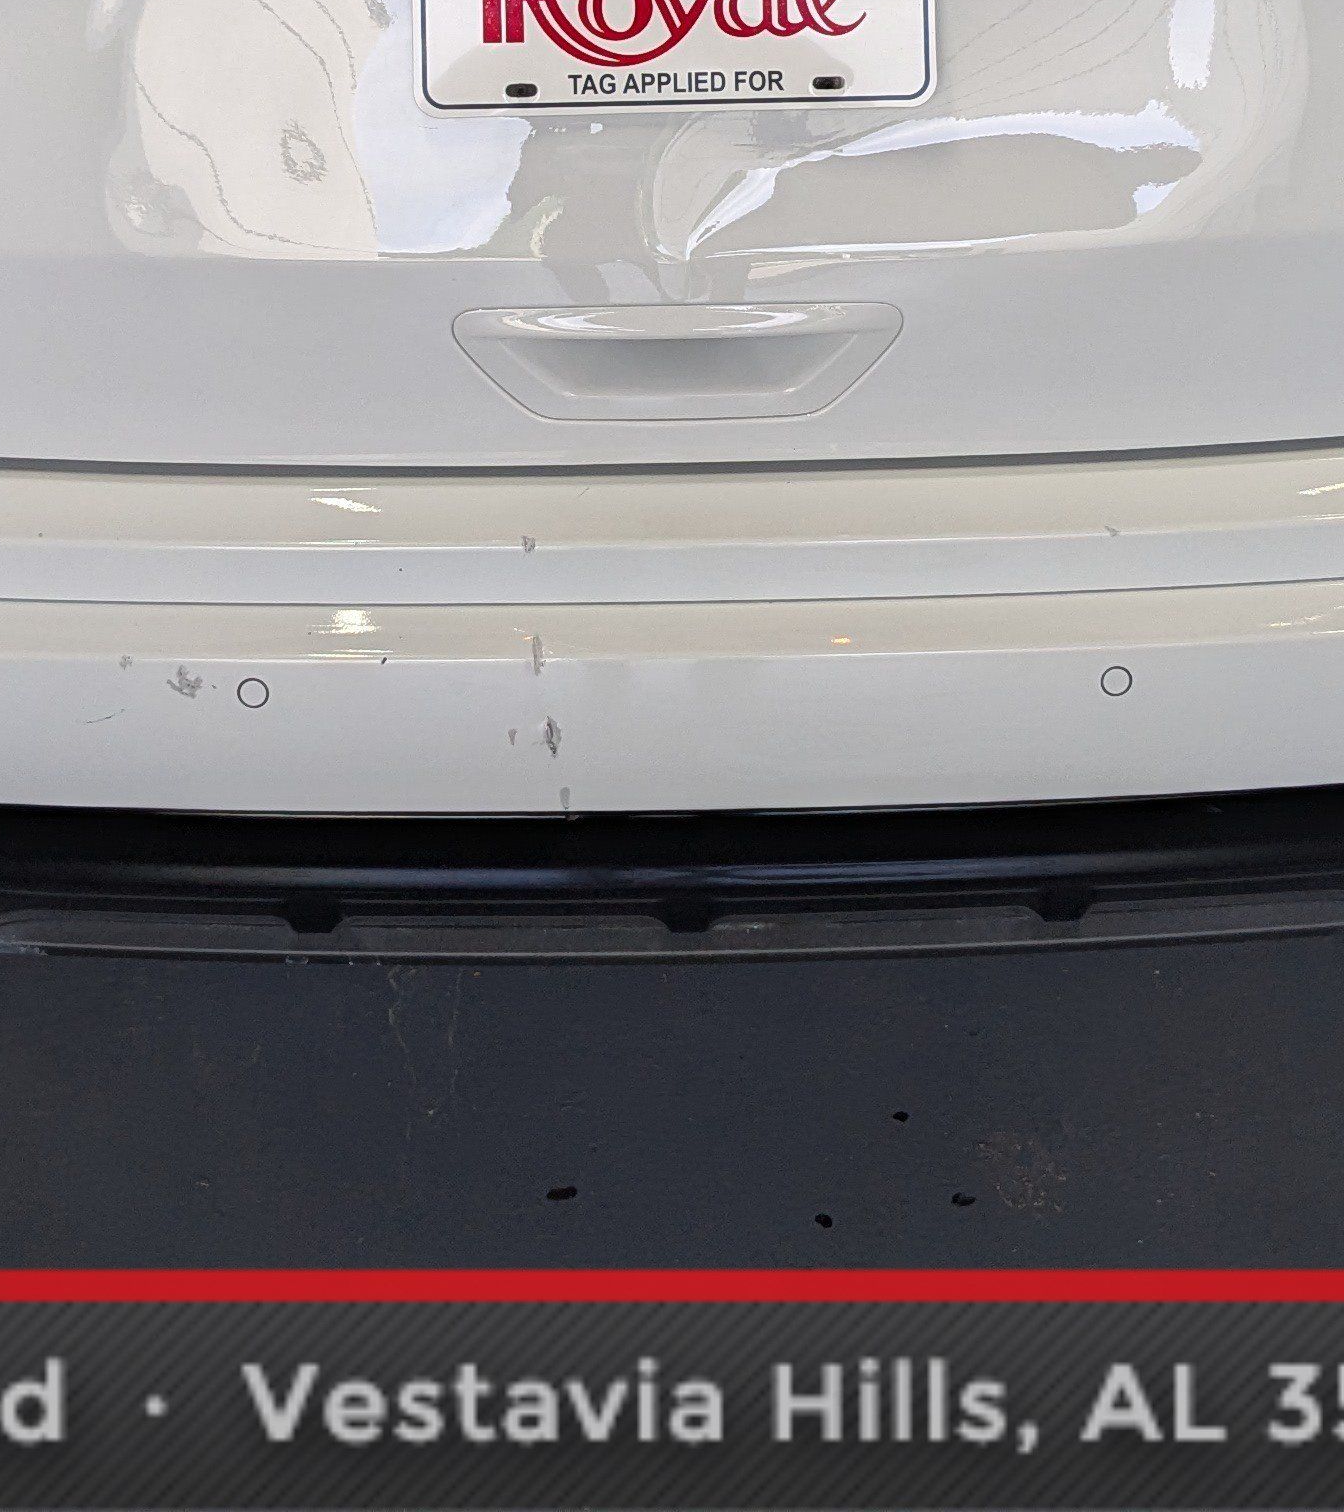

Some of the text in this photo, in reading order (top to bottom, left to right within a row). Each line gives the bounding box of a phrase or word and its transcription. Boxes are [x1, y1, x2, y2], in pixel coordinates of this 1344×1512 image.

[567, 70, 785, 96] TAG APPLIED FOR
